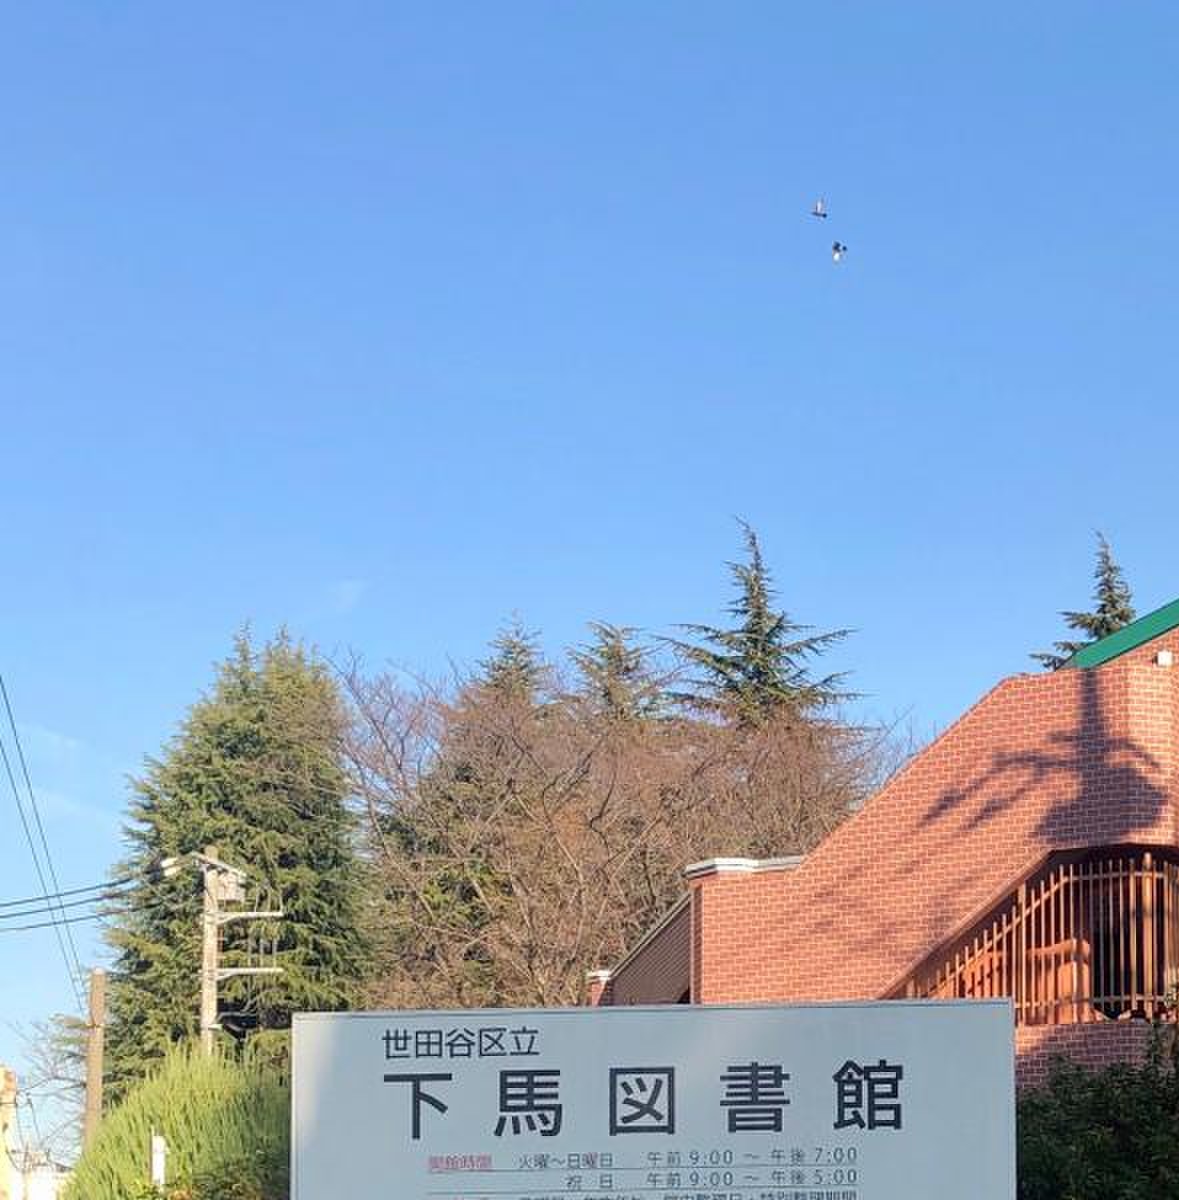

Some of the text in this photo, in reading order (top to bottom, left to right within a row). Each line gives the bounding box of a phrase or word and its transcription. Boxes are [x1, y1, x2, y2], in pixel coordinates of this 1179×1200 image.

[382, 1027, 540, 1058] 世田谷区立
[383, 1059, 904, 1140] 下馬図書館
